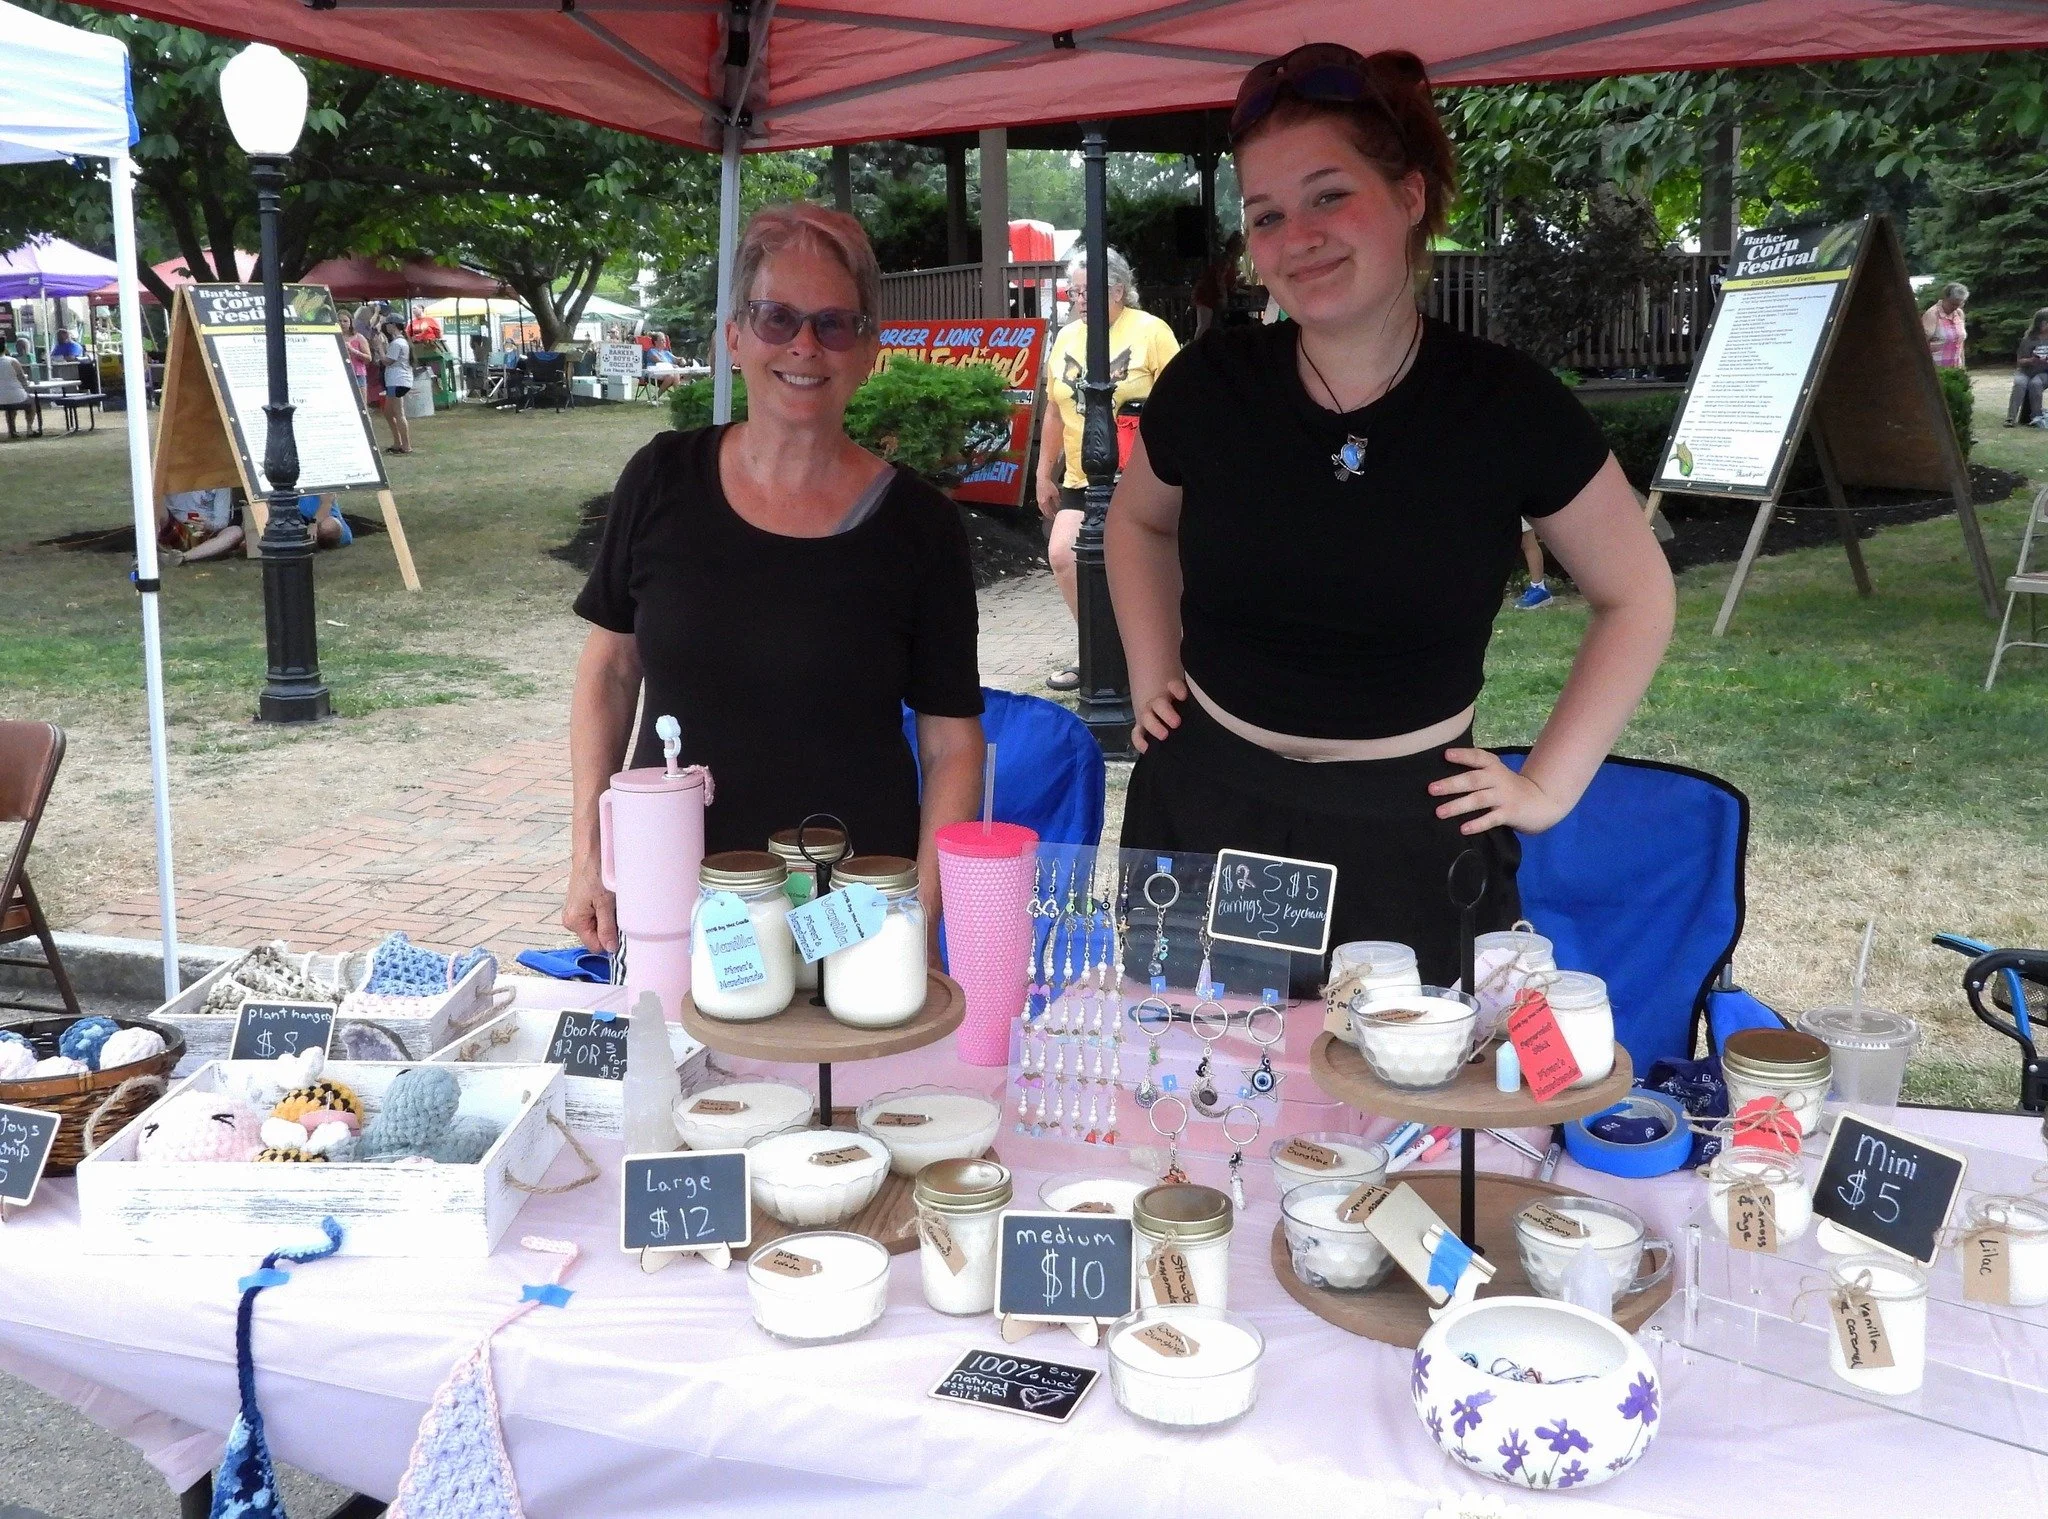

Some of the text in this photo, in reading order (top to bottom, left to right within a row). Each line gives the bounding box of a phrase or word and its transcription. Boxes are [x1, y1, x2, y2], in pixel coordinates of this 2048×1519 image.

[1743, 233, 1787, 246] Barker
[1746, 238, 1799, 261] Corn
[1734, 246, 1819, 277] Festival
[199, 289, 249, 299] Barker
[208, 304, 298, 324] Festial
[879, 326, 1036, 348] ARKER LIONS CLUB
[1286, 871, 1319, 901] $5
[820, 896, 849, 947] Vanilla
[709, 934, 756, 956] Vanilla
[576, 1043, 601, 1066] OR
[646, 1169, 712, 1199] Large
[1837, 1169, 1901, 1224] $5
[649, 1206, 715, 1240] $12
[1016, 1223, 1116, 1246] medium
[1978, 1239, 1999, 1276] Lilac
[1040, 1248, 1105, 1307] $10
[969, 1354, 1042, 1380] 100%
